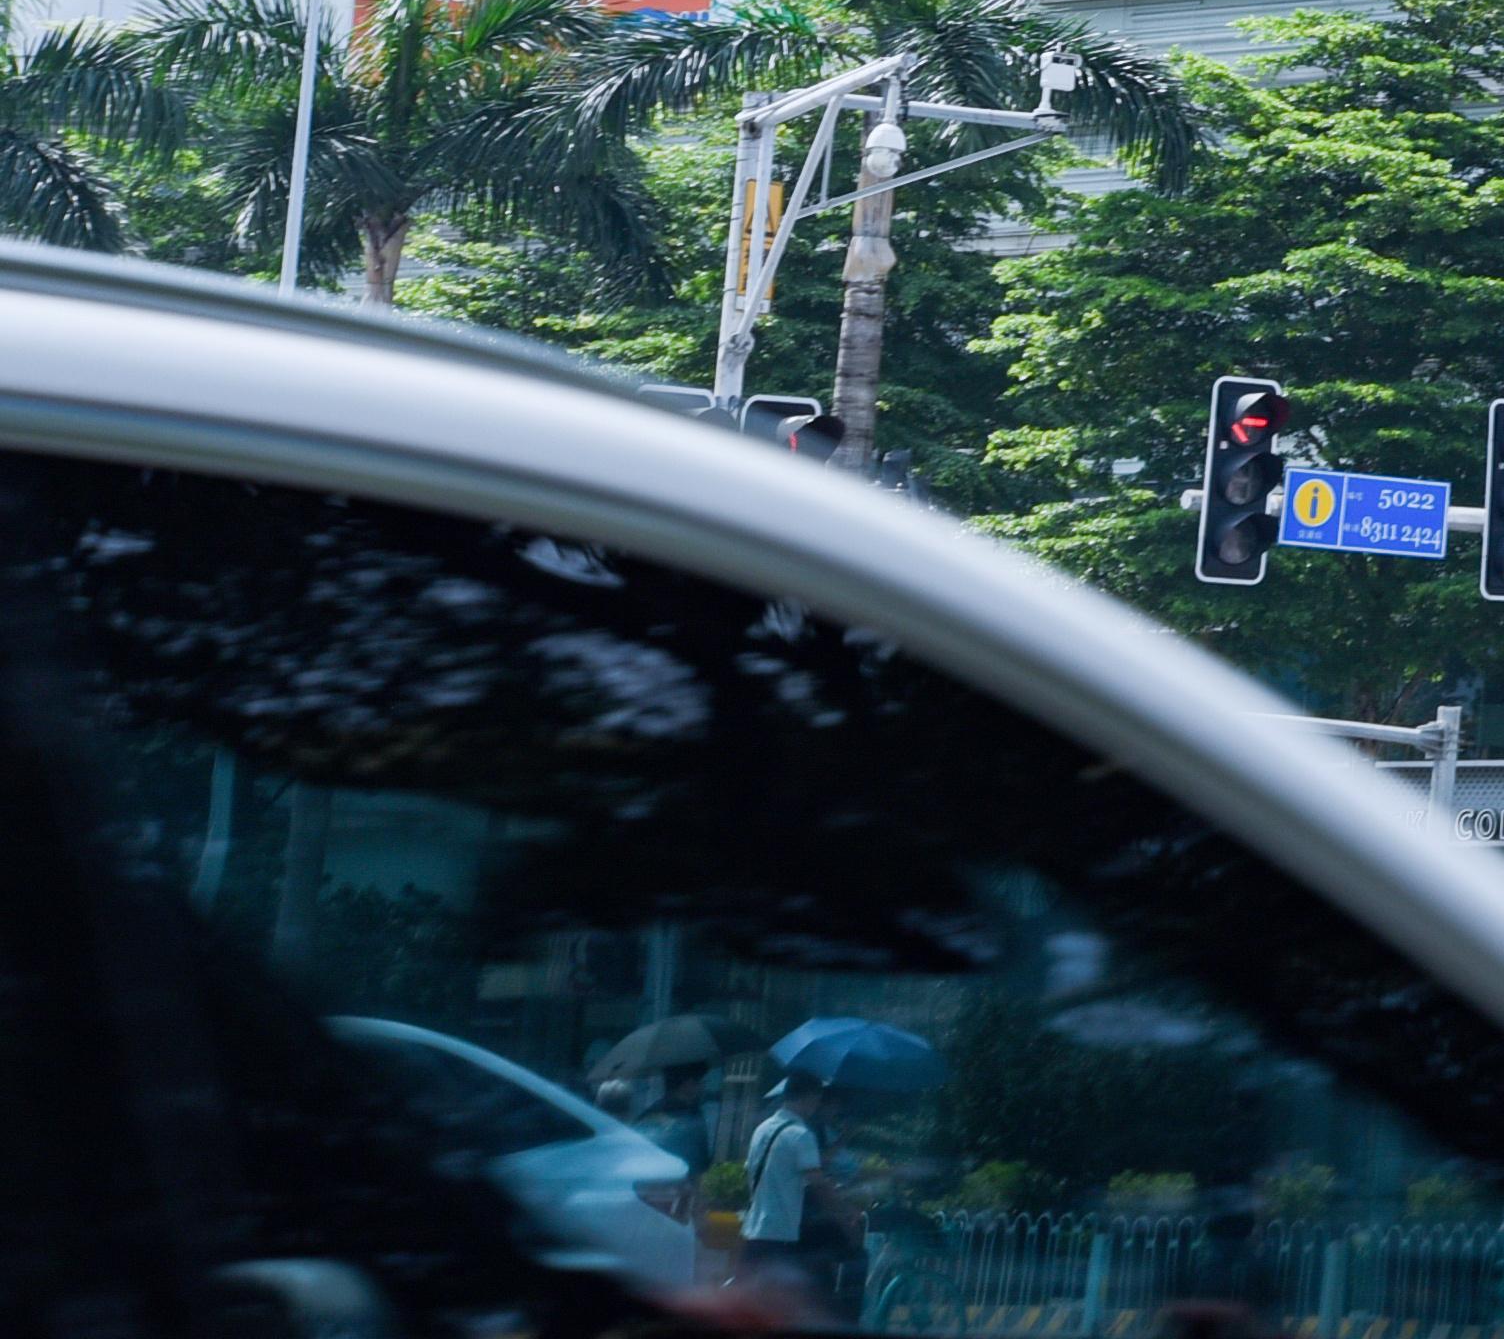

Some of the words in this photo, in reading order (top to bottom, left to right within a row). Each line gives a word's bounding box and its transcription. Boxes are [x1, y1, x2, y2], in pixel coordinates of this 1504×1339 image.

[1377, 489, 1436, 511] 5022
[1360, 516, 1398, 544] 8311
[1401, 525, 1442, 551] 2424
